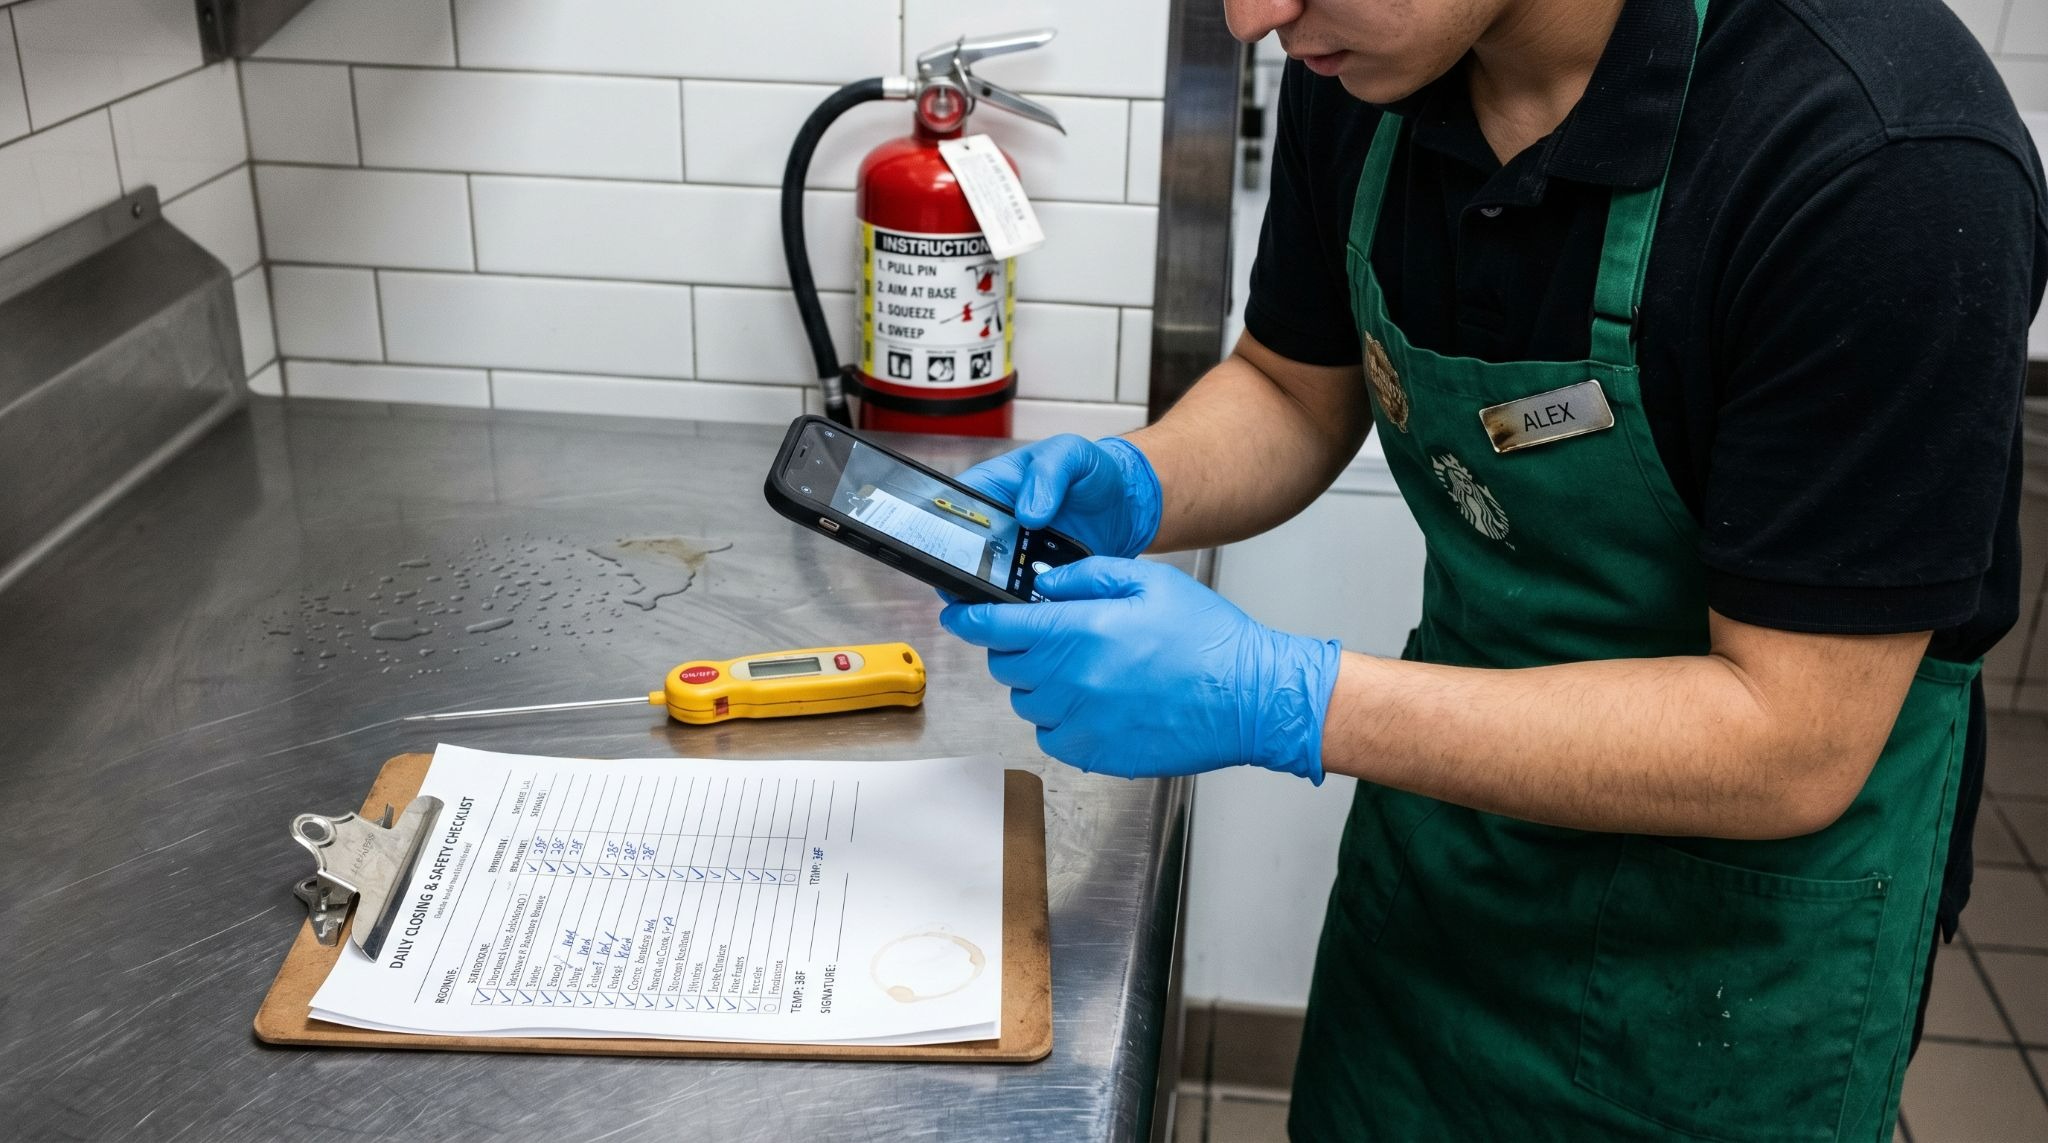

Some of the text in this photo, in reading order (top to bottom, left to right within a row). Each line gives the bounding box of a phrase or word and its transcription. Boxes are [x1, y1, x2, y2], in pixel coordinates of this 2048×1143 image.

[883, 235, 991, 256] INSTRUCTION
[877, 258, 937, 277] 1. PULL PIN
[877, 281, 957, 299] 2. AIM AT BASE
[877, 301, 936, 319] 3. SQUEEZE
[887, 324, 925, 339] SWEEP
[1523, 401, 1576, 432] ALEX
[445, 796, 475, 845] CHECKLIST
[429, 846, 453, 881] SAFETY
[424, 882, 439, 891] &
[405, 892, 434, 937] CLOSING
[389, 938, 414, 969] DAILY
[790, 970, 806, 1014] TEMP: 38F
[821, 964, 836, 1014] SIGNATURE:
